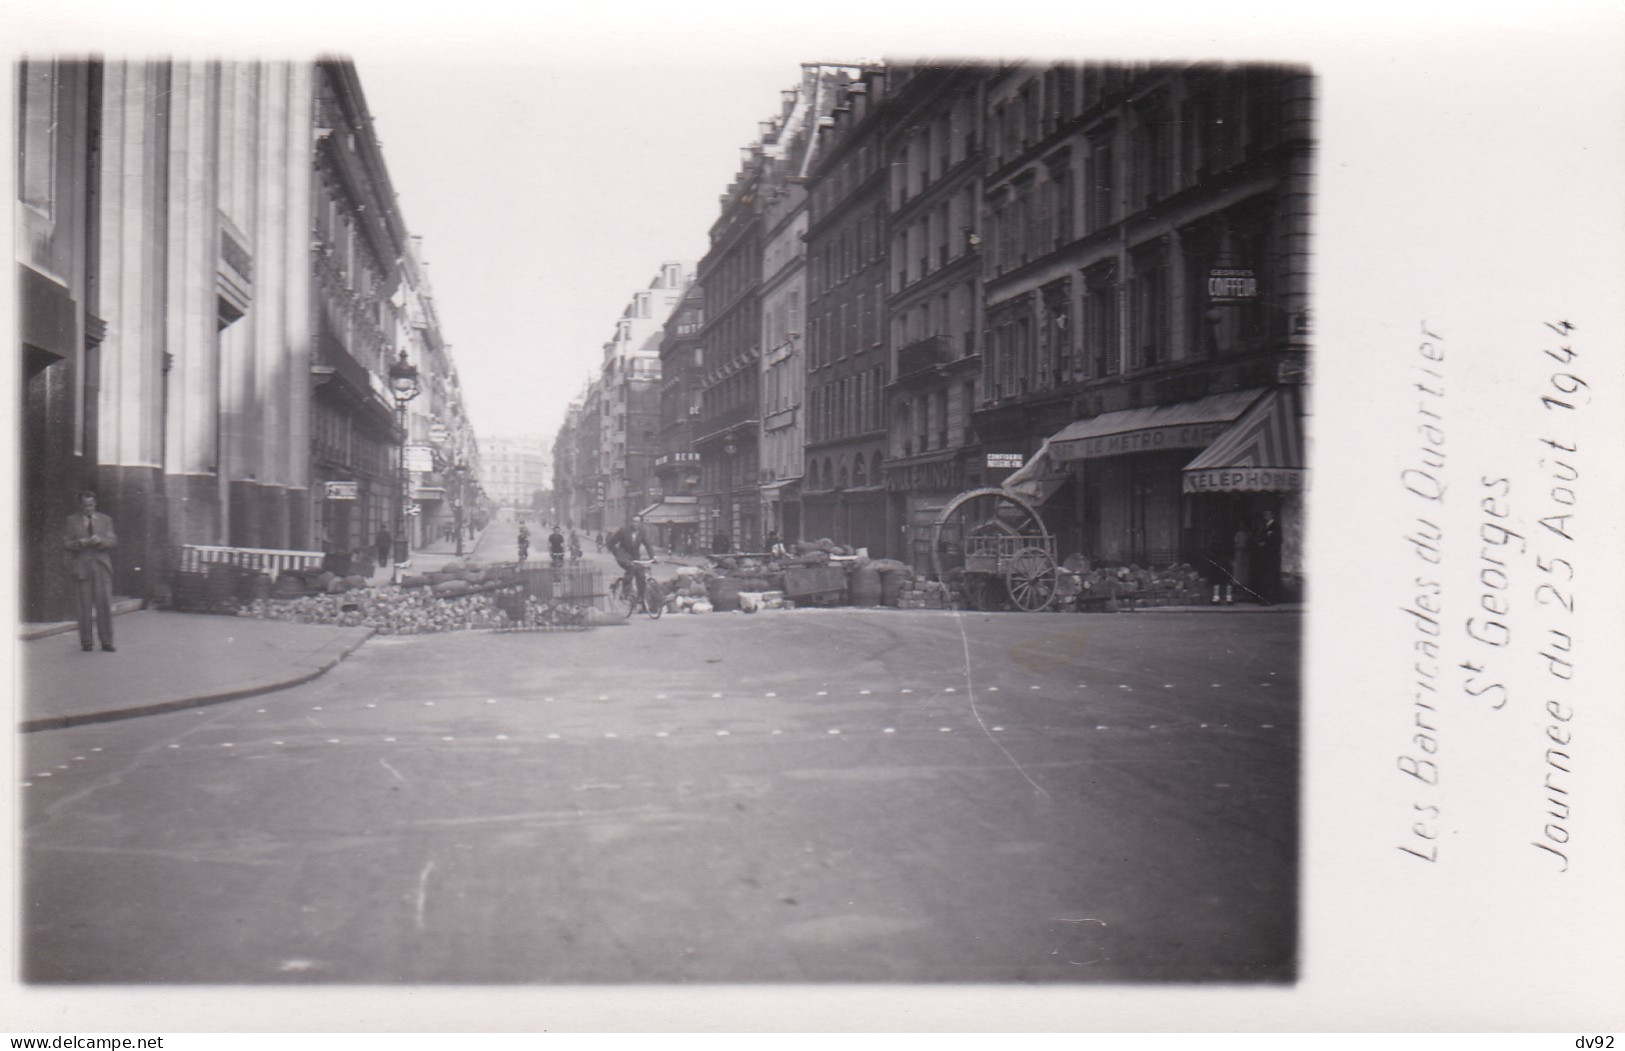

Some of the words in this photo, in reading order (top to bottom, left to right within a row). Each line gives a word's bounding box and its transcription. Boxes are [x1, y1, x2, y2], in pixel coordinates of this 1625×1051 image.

[1208, 278, 1257, 297] COIFFEUR
[1540, 319, 1591, 411] 1944
[1399, 319, 1448, 505] Quartier
[1086, 439, 1104, 456] LE
[1402, 518, 1442, 565] du
[1465, 474, 1527, 648] Georges
[1534, 554, 1575, 614] 25
[1396, 577, 1442, 786] Barricades
[1538, 629, 1574, 681] du
[1396, 804, 1440, 864] Les
